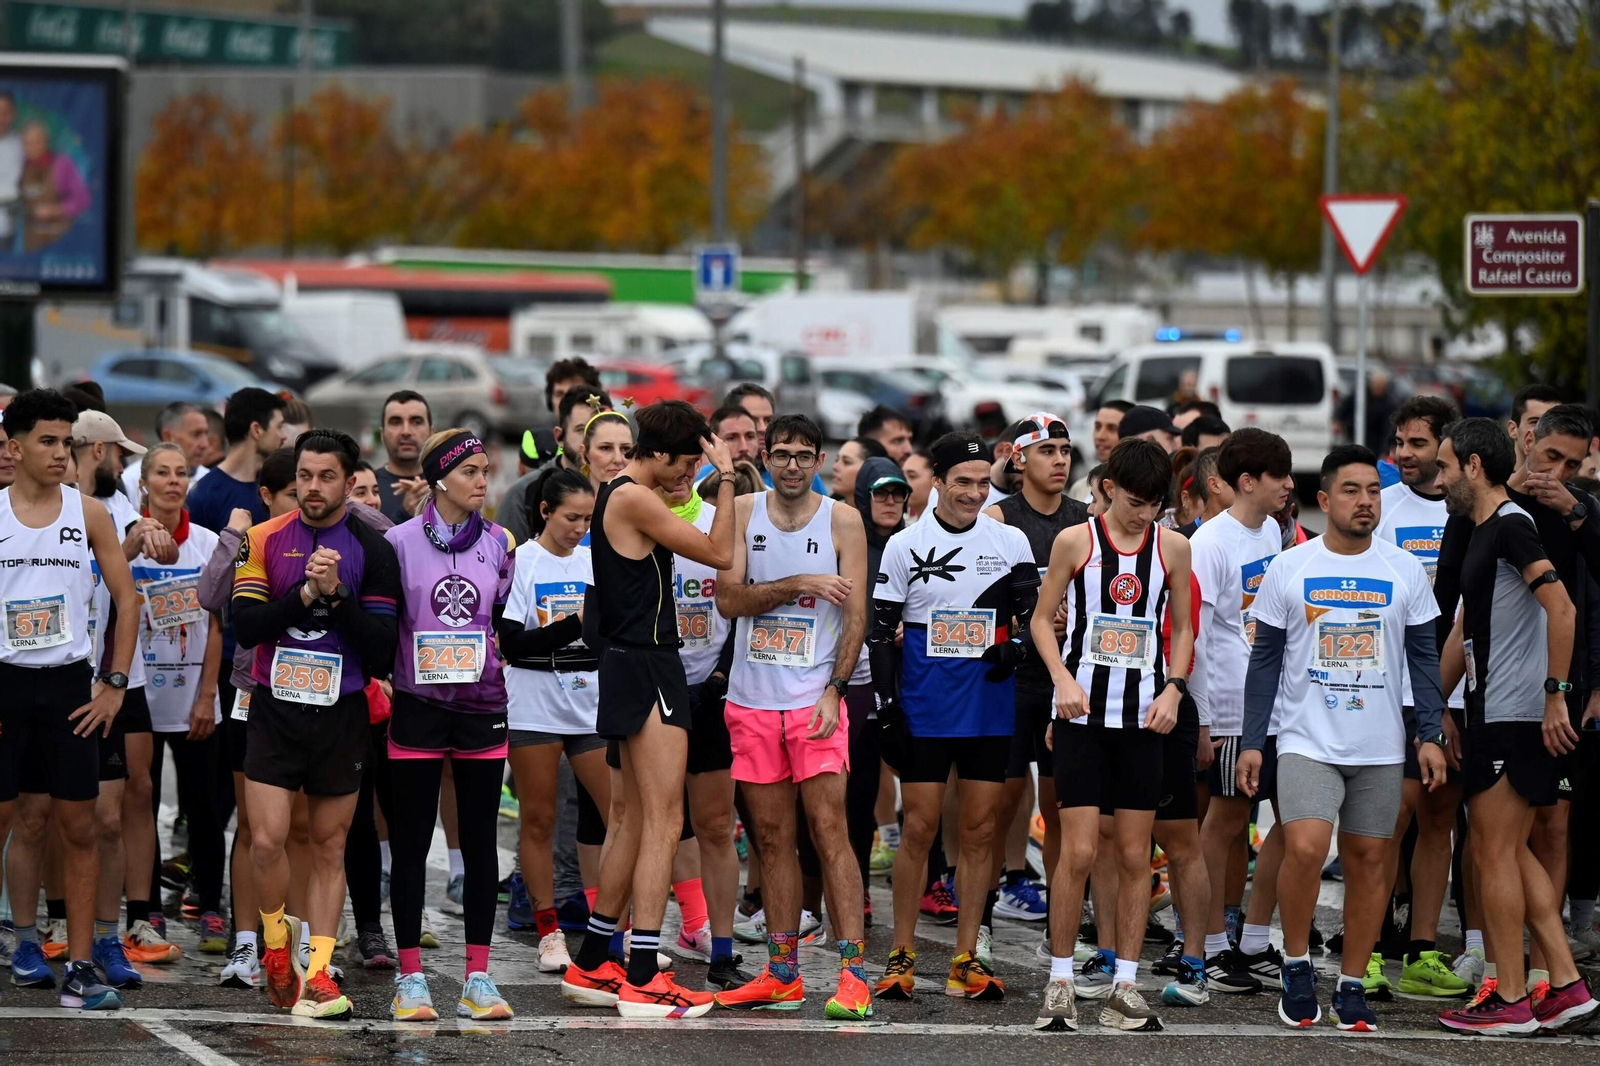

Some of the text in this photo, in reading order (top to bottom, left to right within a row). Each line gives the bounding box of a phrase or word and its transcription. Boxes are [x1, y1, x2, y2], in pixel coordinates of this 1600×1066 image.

[1506, 226, 1566, 244] Avenida
[1482, 248, 1566, 267] Compositor
[1478, 267, 1572, 284] Rafael Castro
[1402, 539, 1442, 551] CORDO
[0, 558, 80, 569] TOP4RUNNING
[160, 570, 174, 580] 12
[563, 584, 577, 594] 12
[1340, 580, 1357, 590] 12
[150, 587, 200, 619] 232
[1309, 589, 1387, 605] CORDOBARIA
[16, 610, 51, 637] 57
[751, 627, 805, 653] 347
[931, 621, 986, 646] 343
[1100, 629, 1138, 655] 89
[1320, 633, 1374, 658] 122
[418, 646, 476, 671] 242
[274, 662, 331, 692] 259
